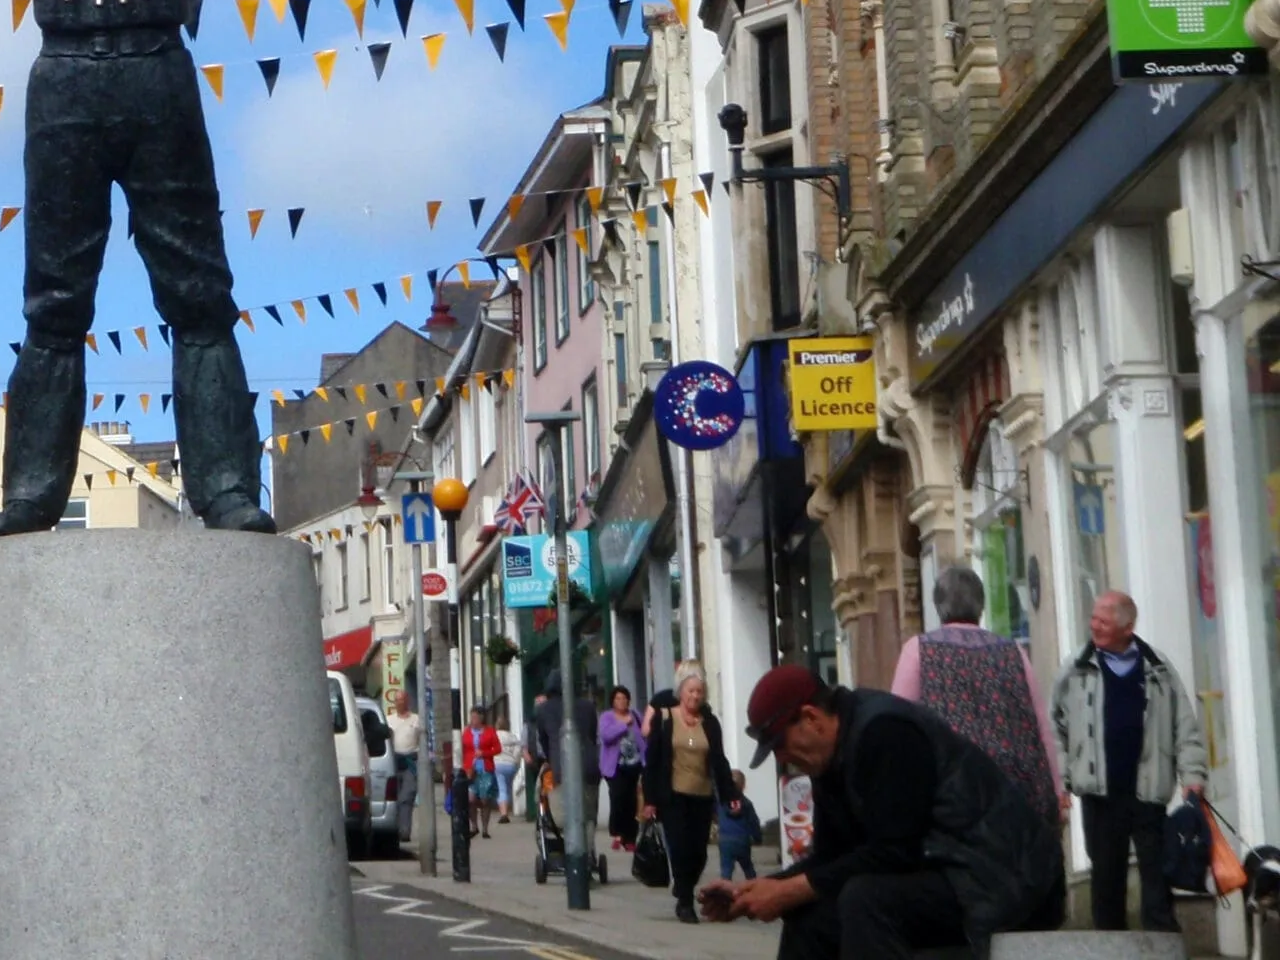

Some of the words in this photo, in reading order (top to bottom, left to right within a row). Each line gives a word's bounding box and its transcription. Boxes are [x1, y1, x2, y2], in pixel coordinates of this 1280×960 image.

[1144, 61, 1239, 75] Superdrug
[800, 352, 857, 364] Premier
[820, 376, 853, 394] Off
[800, 400, 875, 416] Licence
[549, 545, 574, 555] FR
[506, 555, 531, 567] SBC
[547, 555, 577, 566] SE
